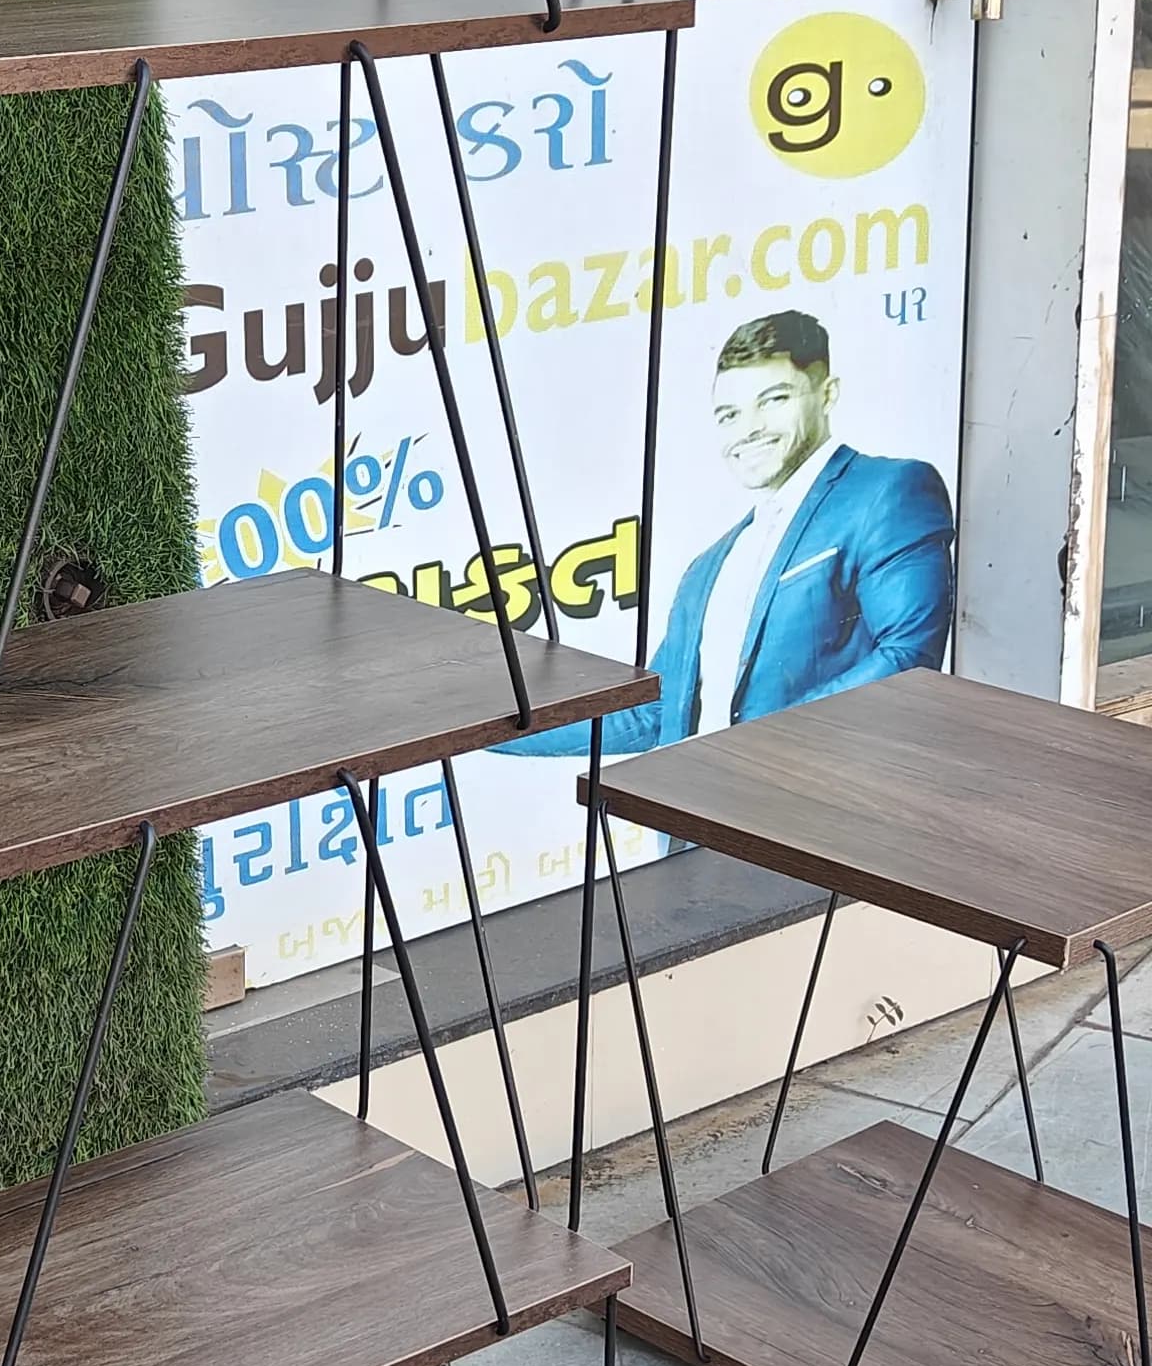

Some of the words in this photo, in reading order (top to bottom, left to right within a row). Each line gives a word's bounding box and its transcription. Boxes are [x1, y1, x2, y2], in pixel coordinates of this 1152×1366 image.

[457, 59, 614, 182] કરો
[881, 286, 928, 327] પર
[216, 436, 445, 580] 00%
